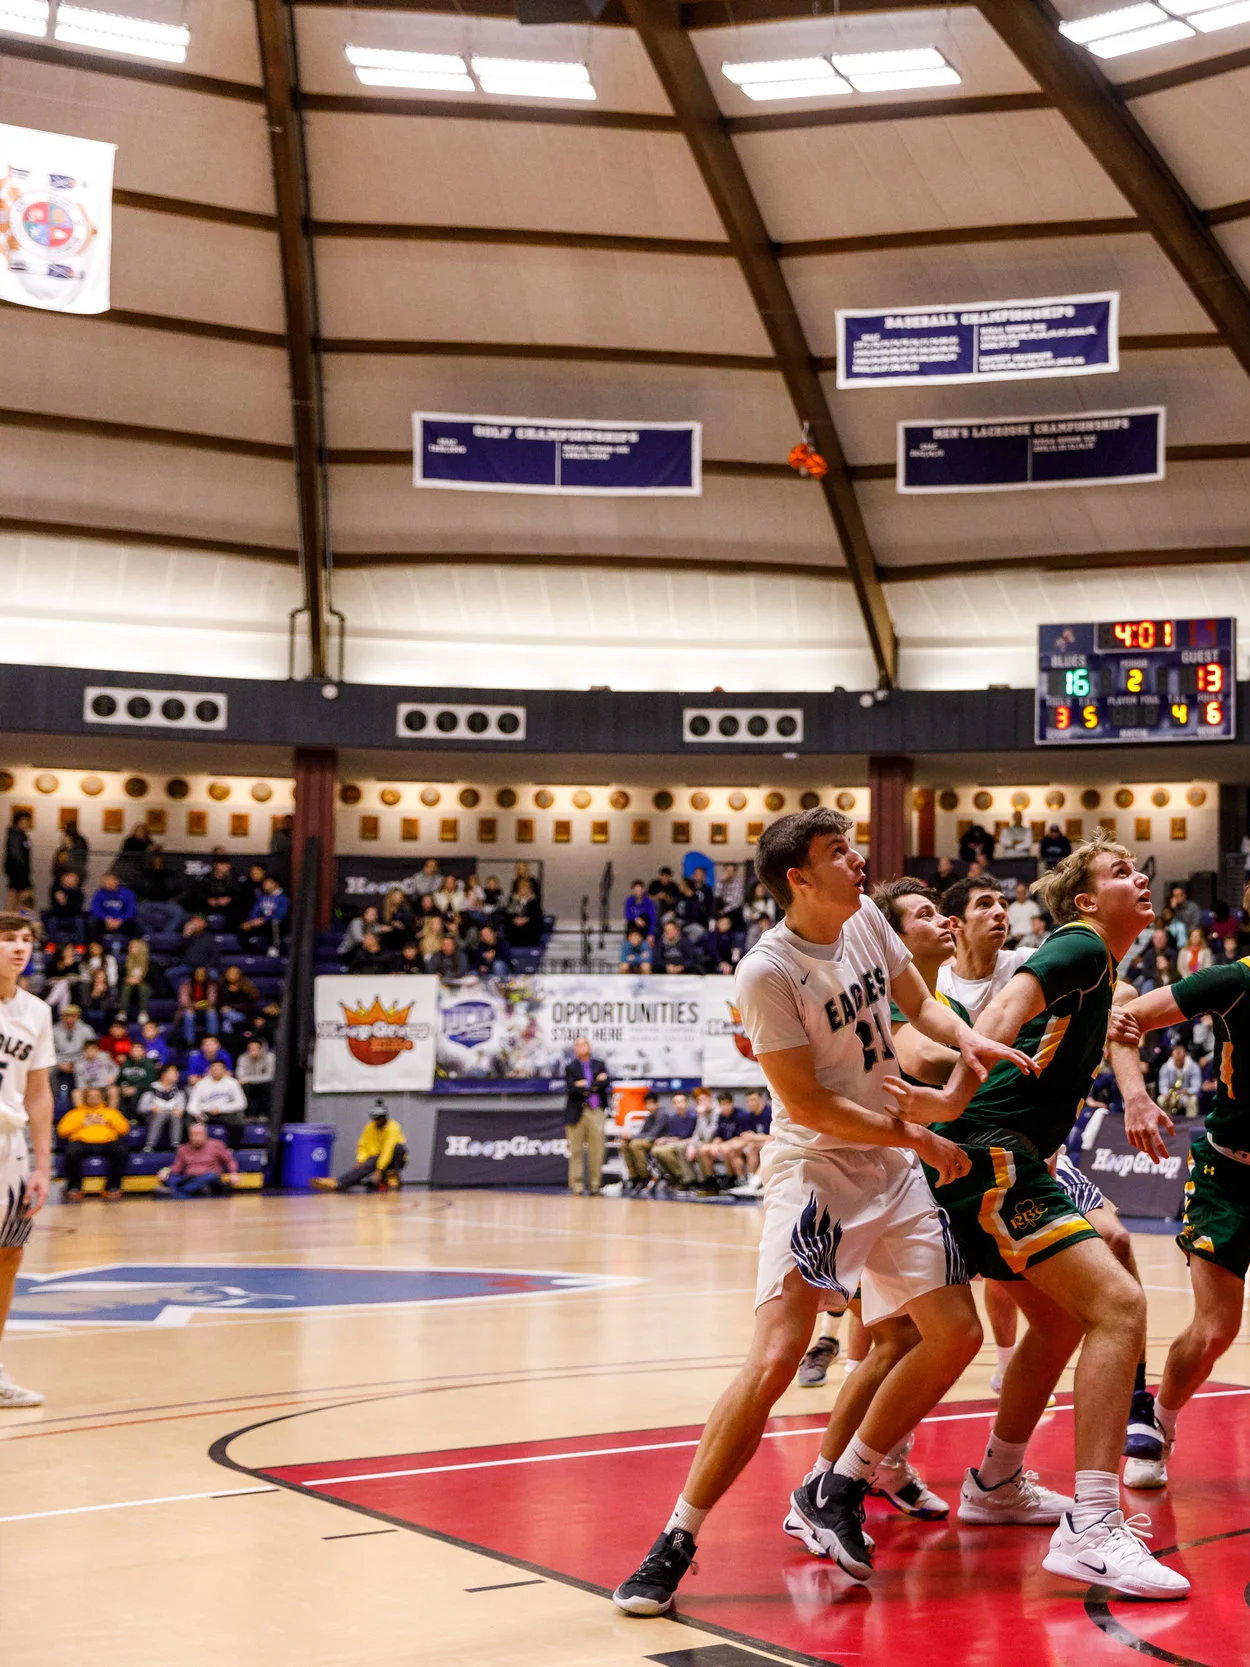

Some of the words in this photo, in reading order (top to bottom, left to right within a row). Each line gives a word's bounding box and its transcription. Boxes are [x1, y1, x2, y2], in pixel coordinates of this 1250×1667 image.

[1114, 620, 1173, 648] 4:01
[1181, 650, 1220, 664] GUEST
[1065, 667, 1090, 697] 16
[1126, 667, 1143, 693] 2
[1196, 662, 1223, 693] 13
[1055, 705, 1071, 730] 3
[1082, 704, 1098, 729] 5
[1171, 703, 1188, 724] 4
[1205, 700, 1223, 726] 6
[824, 966, 886, 1033] EAGES
[551, 1001, 699, 1024] OPPORTUNITIES
[591, 1027, 624, 1042] HERE
